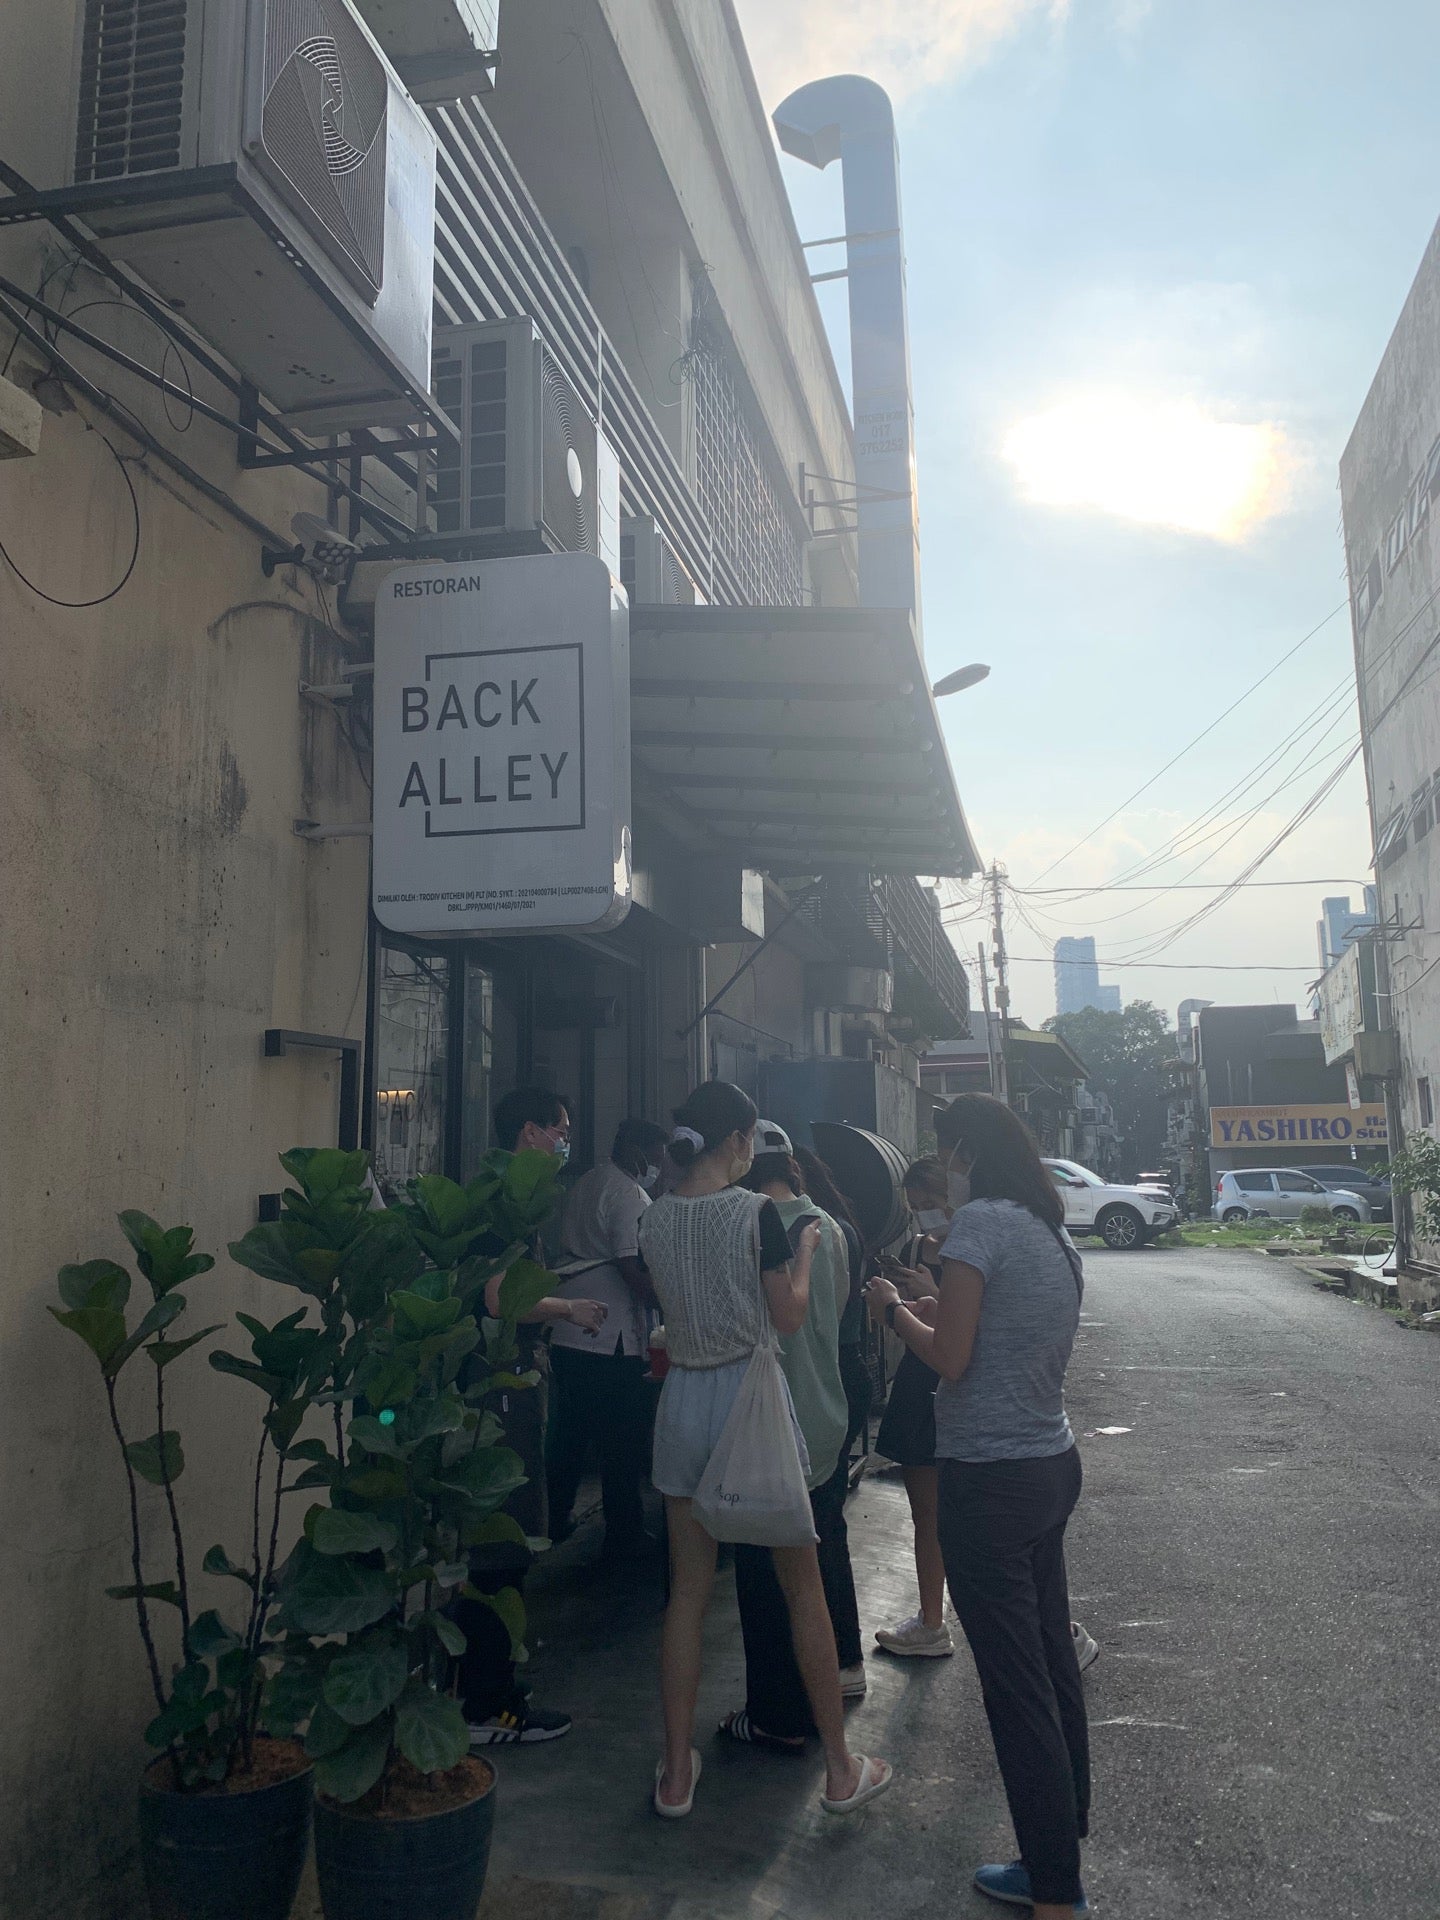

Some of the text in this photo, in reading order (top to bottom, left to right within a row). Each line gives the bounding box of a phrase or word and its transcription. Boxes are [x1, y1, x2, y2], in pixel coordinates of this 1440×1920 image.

[393, 575, 481, 599] RESTORAN
[402, 678, 542, 733] BACK
[399, 751, 569, 808] ALLEY
[400, 893, 416, 902] OLEH
[440, 891, 465, 900] KITCHEN
[475, 890, 485, 899] PLT
[379, 1086, 429, 1123] BACK
[1218, 1117, 1352, 1142] YASHIRO
